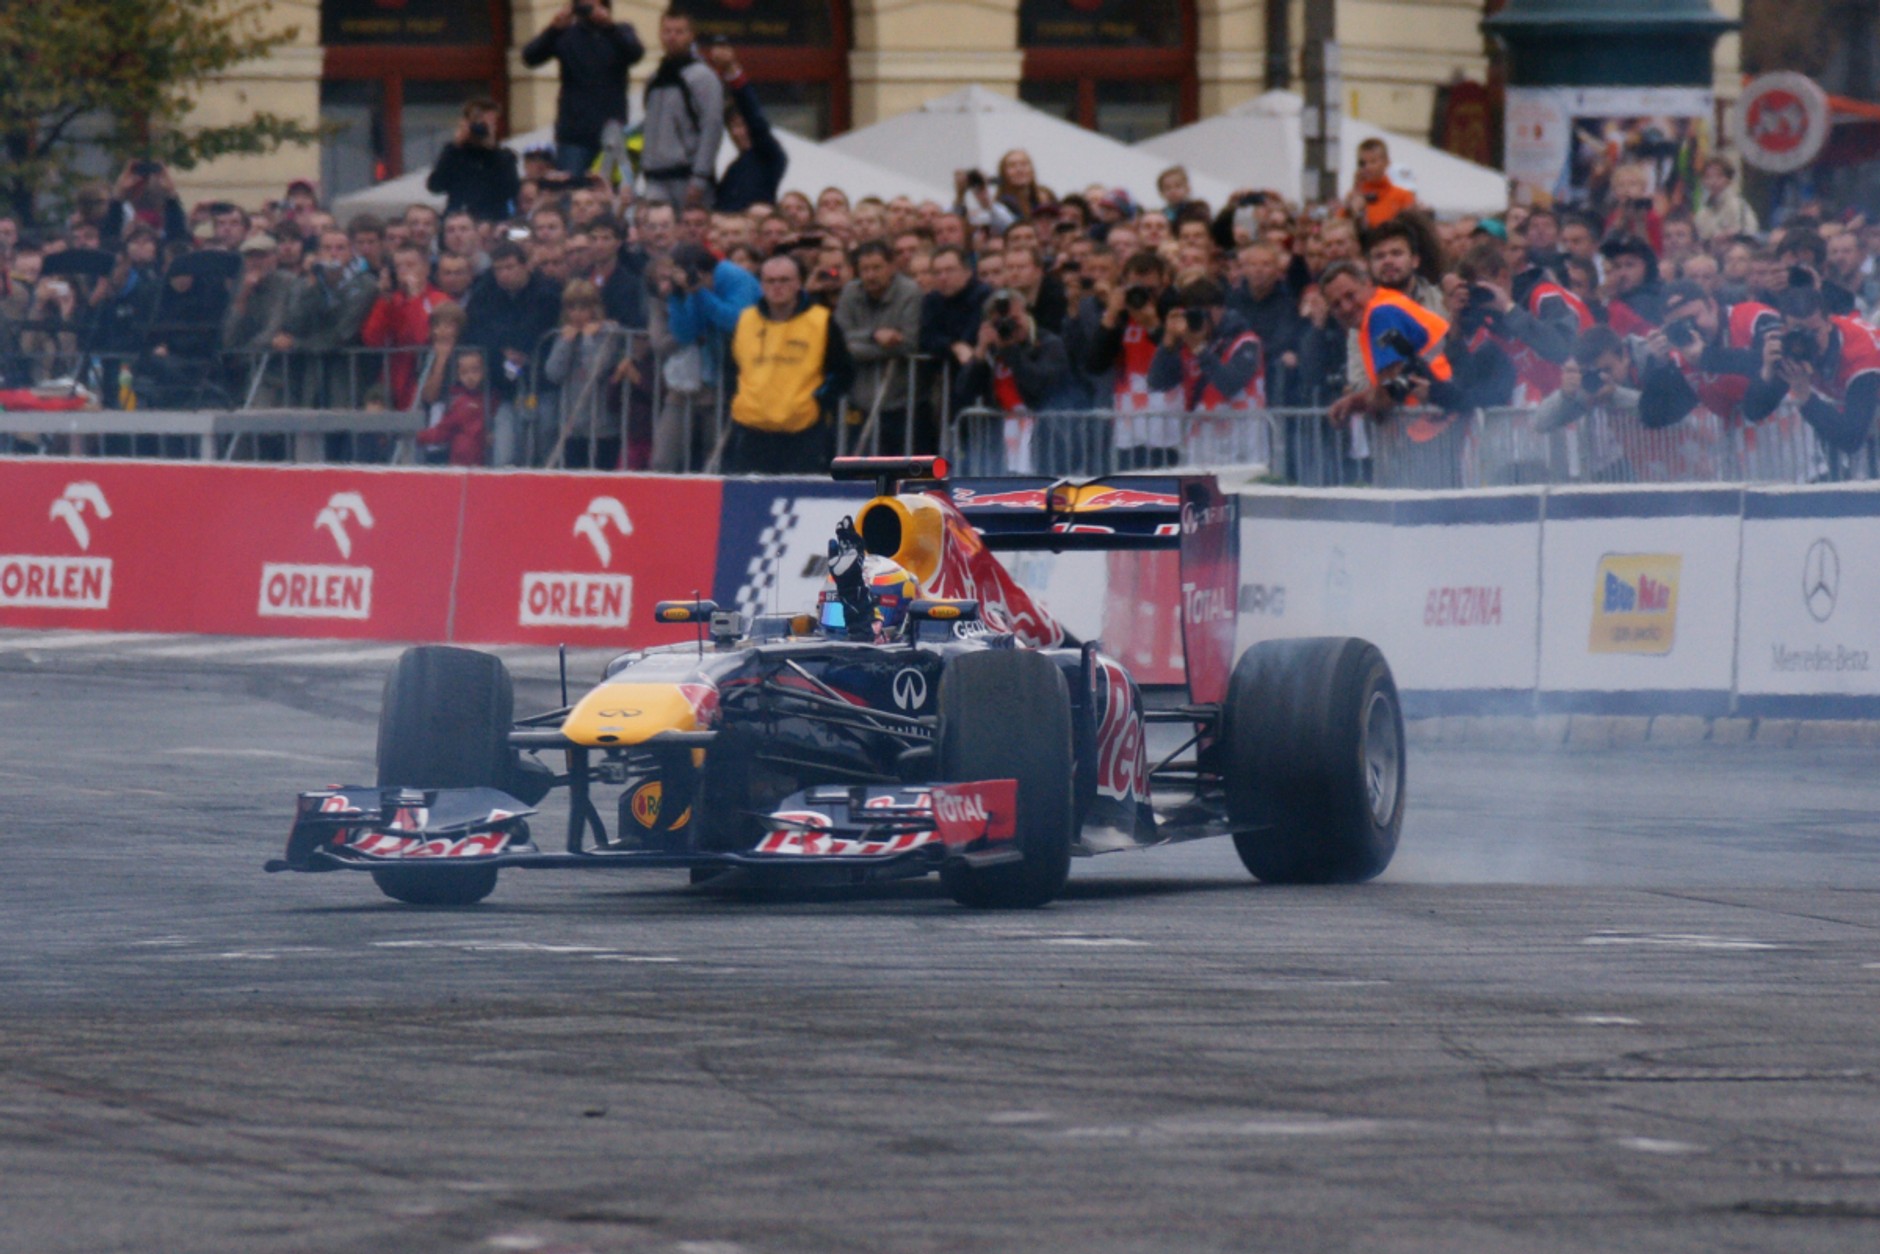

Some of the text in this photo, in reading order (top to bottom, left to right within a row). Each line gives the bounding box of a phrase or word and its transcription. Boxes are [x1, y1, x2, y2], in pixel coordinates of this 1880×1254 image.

[2, 562, 104, 599] ORLEN
[267, 572, 363, 610] ORLEN
[528, 581, 623, 617] ORLEN
[1182, 582, 1233, 624] TOTAL
[1424, 586, 1502, 626] BENZINA
[932, 790, 989, 823] TOTAL
